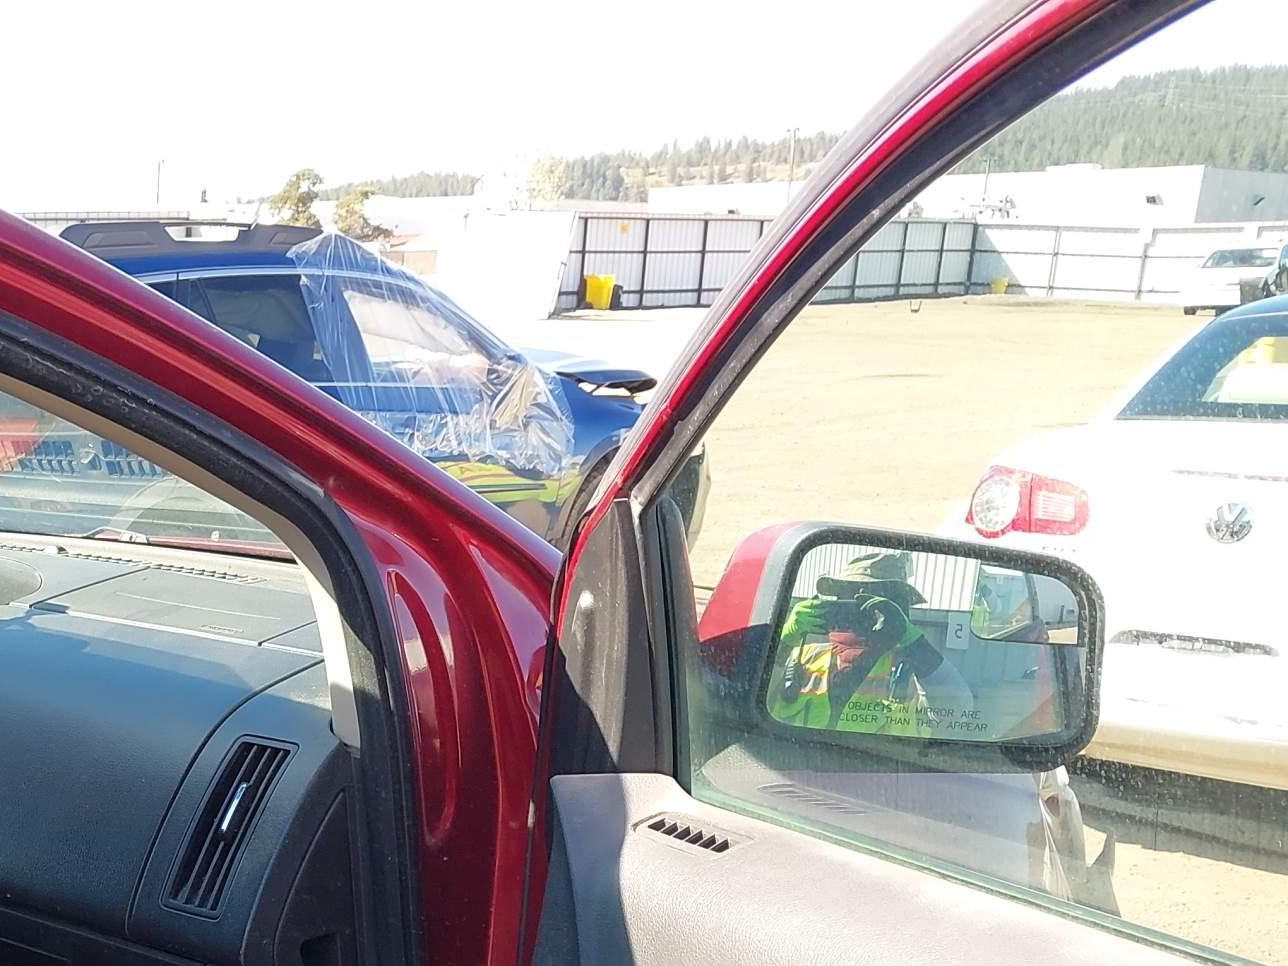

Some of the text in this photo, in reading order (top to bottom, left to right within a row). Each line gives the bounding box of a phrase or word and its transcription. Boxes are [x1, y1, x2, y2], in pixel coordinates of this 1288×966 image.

[848, 701, 982, 720] OBJECTS IN MIRROR ARE
[839, 711, 988, 732] CLOSER THAN THEY APPEAR
